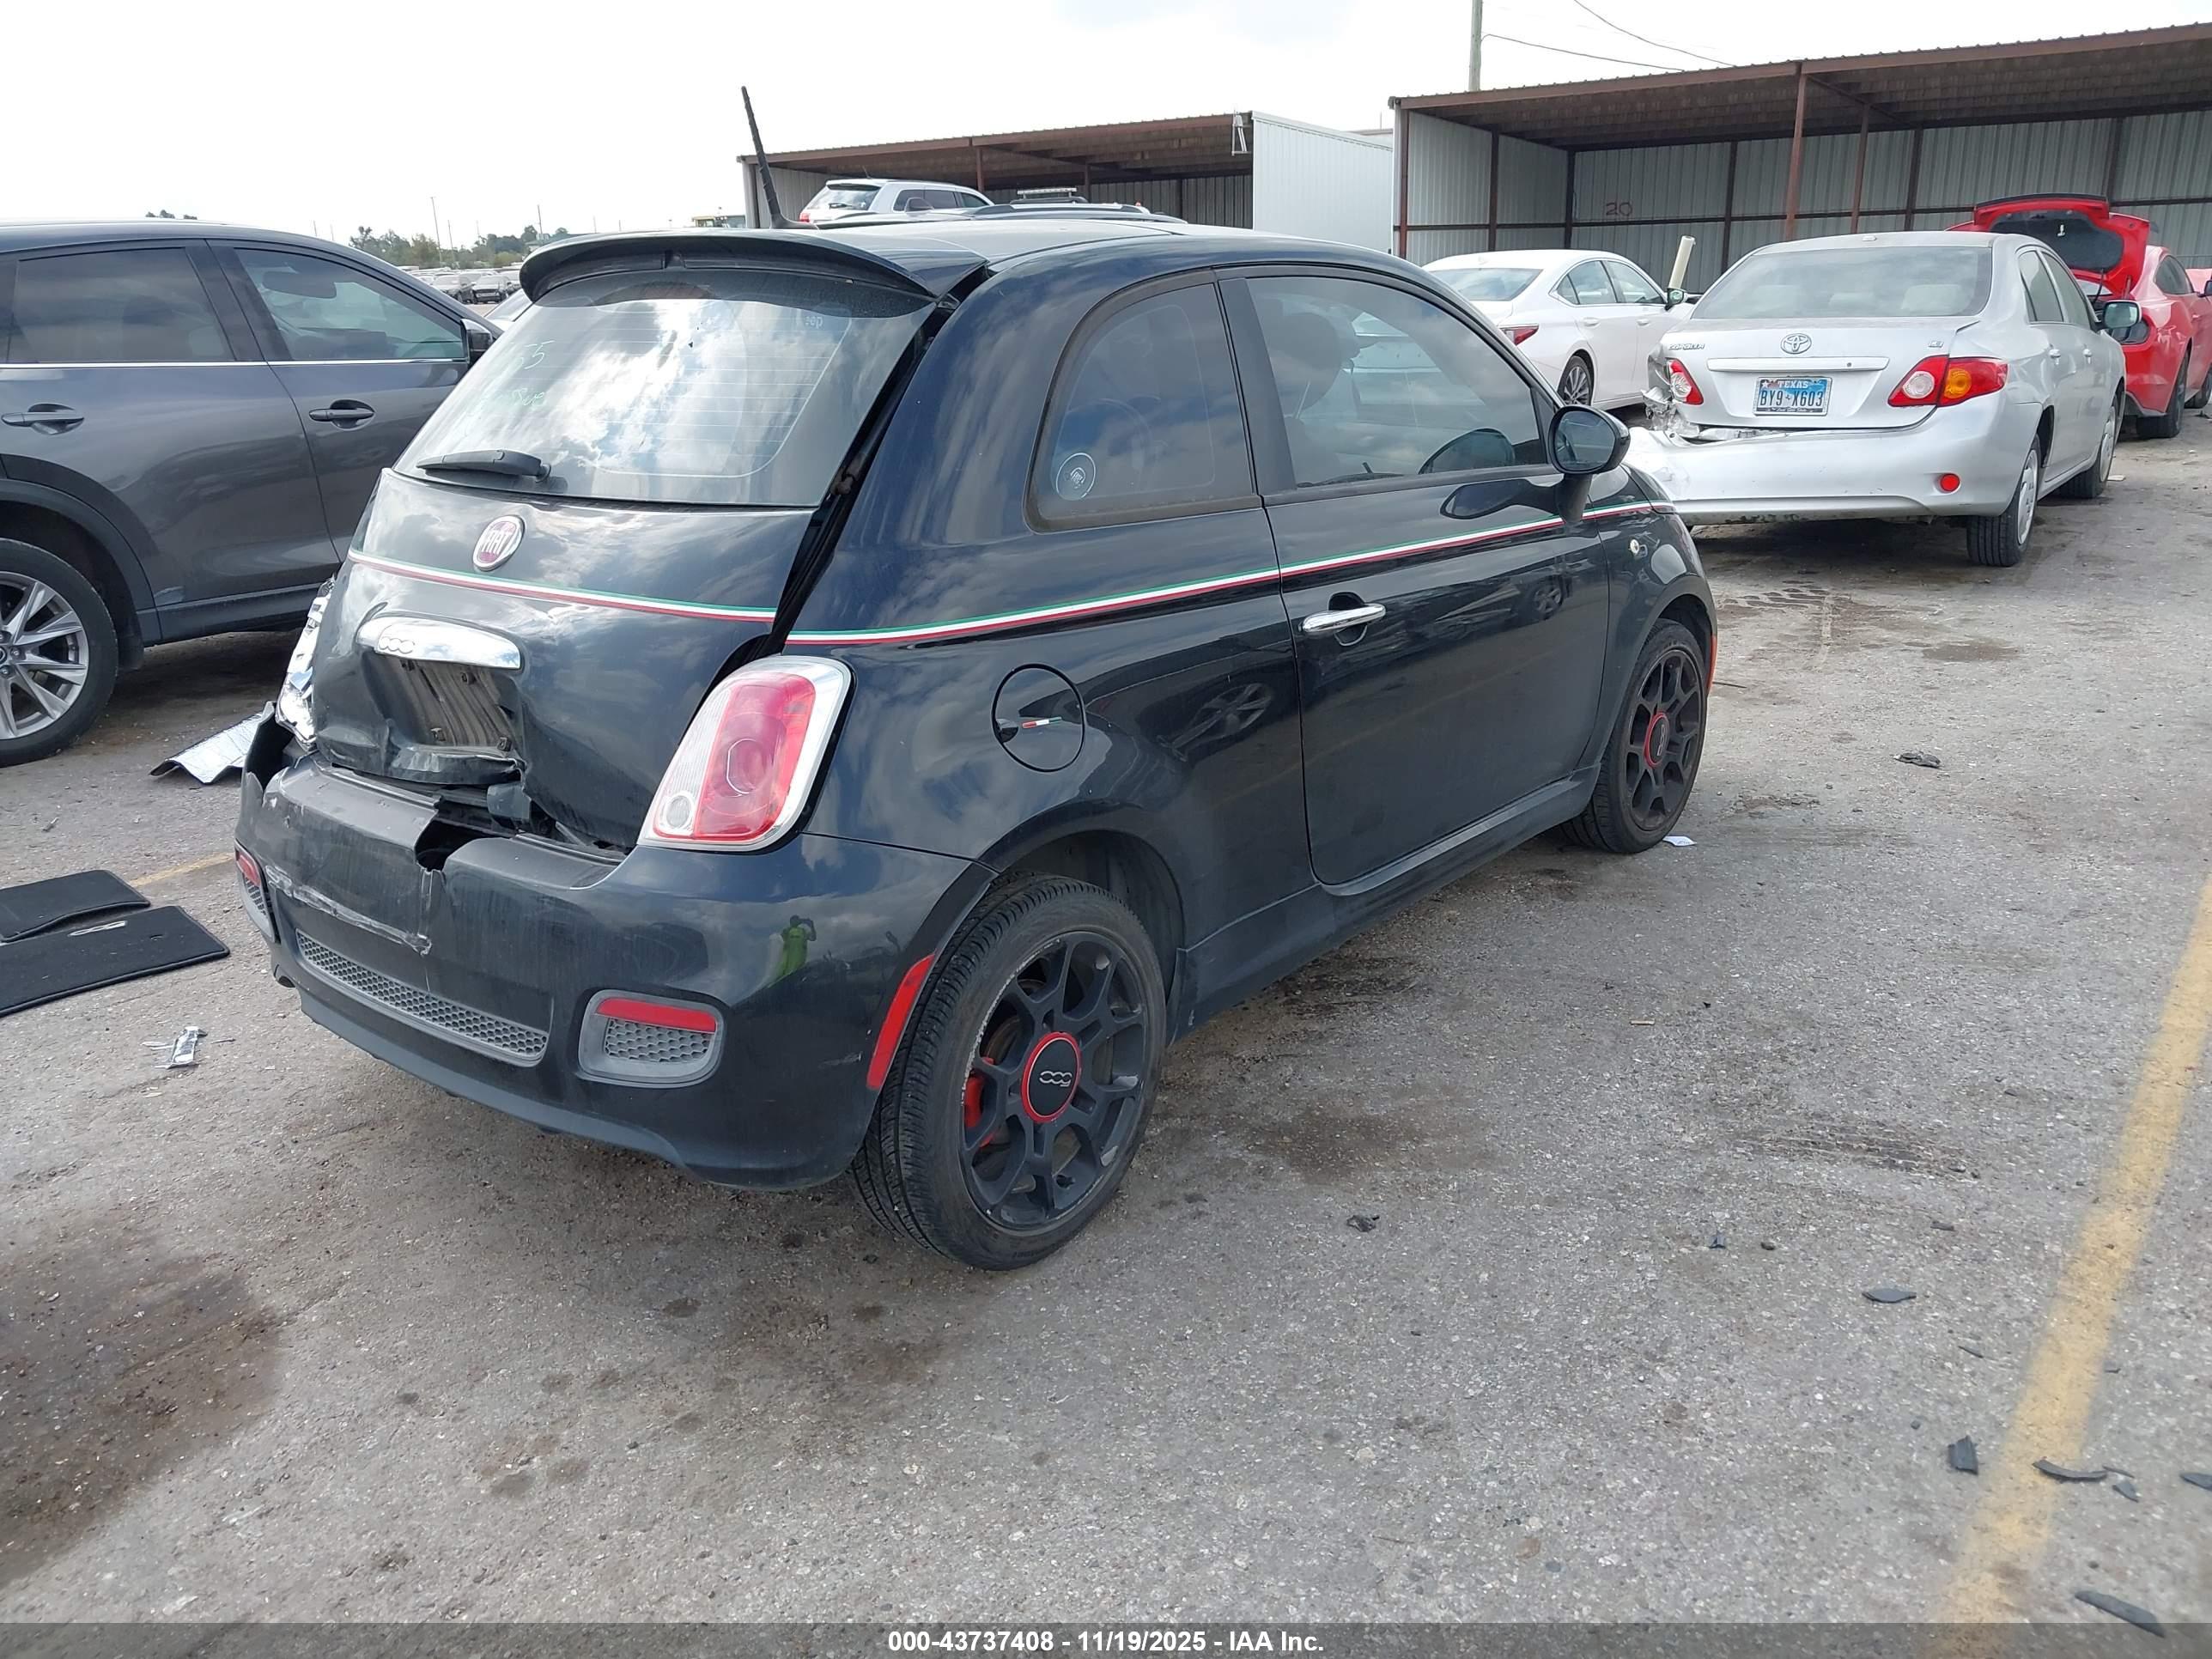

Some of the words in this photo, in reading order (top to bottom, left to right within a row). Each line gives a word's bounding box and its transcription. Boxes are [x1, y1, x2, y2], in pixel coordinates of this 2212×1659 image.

[1606, 202, 1633, 216] 20
[1778, 380, 1808, 389] TEXAS
[480, 527, 516, 555] FIAT
[1039, 1070, 1073, 1087] 500
